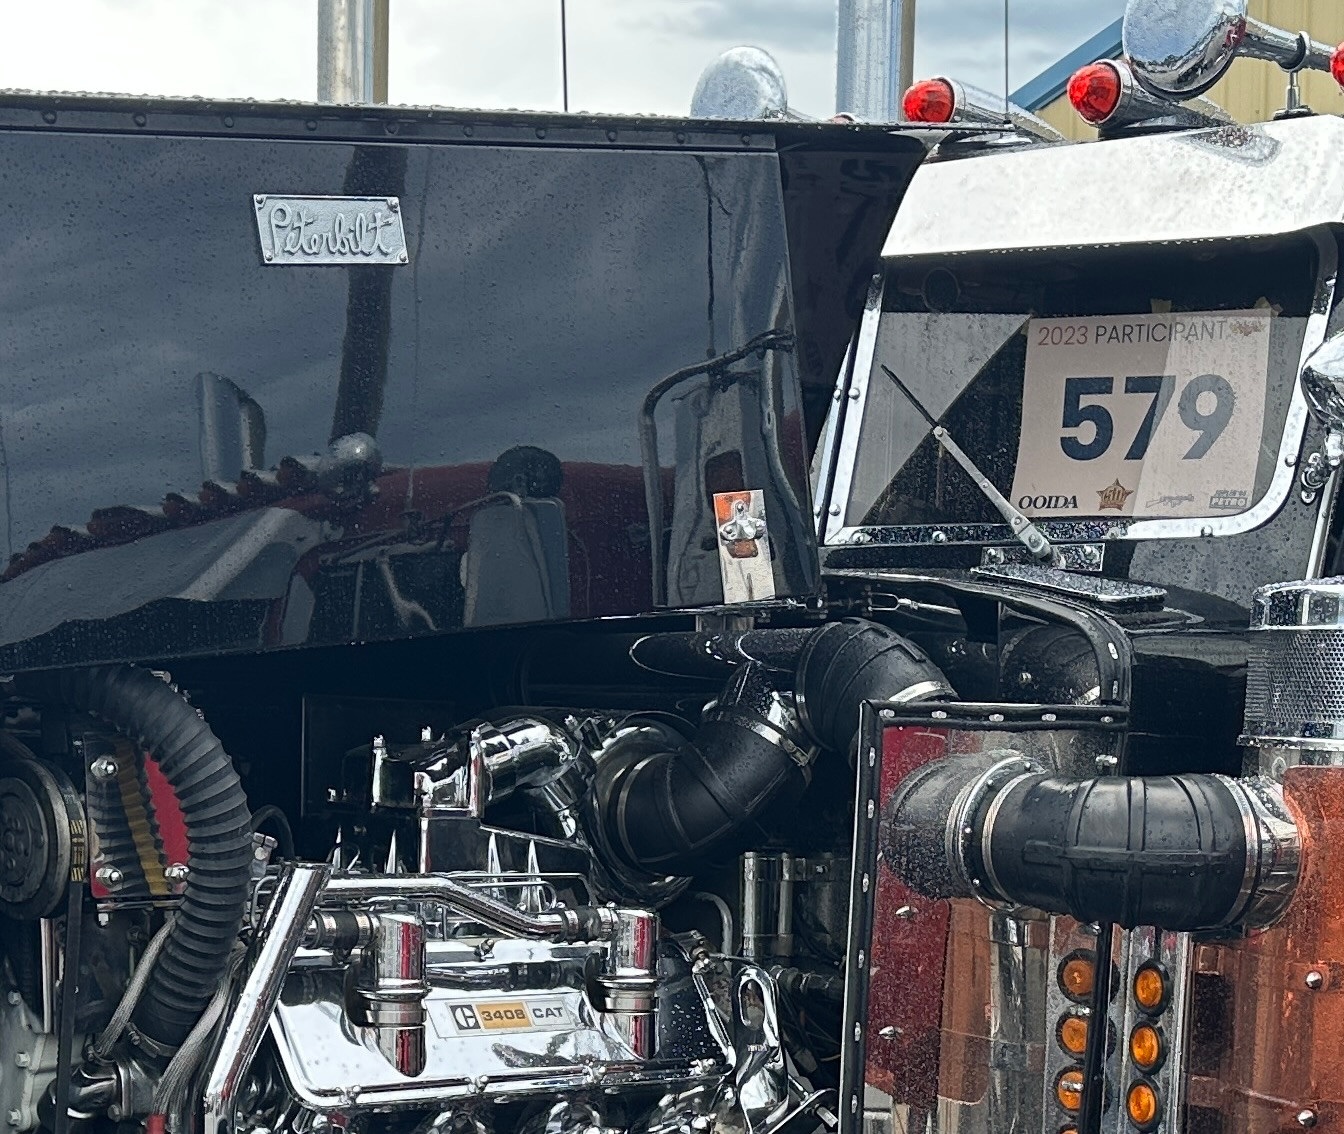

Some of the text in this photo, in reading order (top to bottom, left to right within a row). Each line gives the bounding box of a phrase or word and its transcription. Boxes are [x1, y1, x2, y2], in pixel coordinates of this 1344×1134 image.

[269, 203, 397, 257] Peterbilt
[1038, 320, 1228, 346] 2023 PARTICIPANT
[1059, 374, 1238, 462] 579
[1018, 495, 1079, 510] OOIDA
[481, 1006, 564, 1022] 3408 CAT
